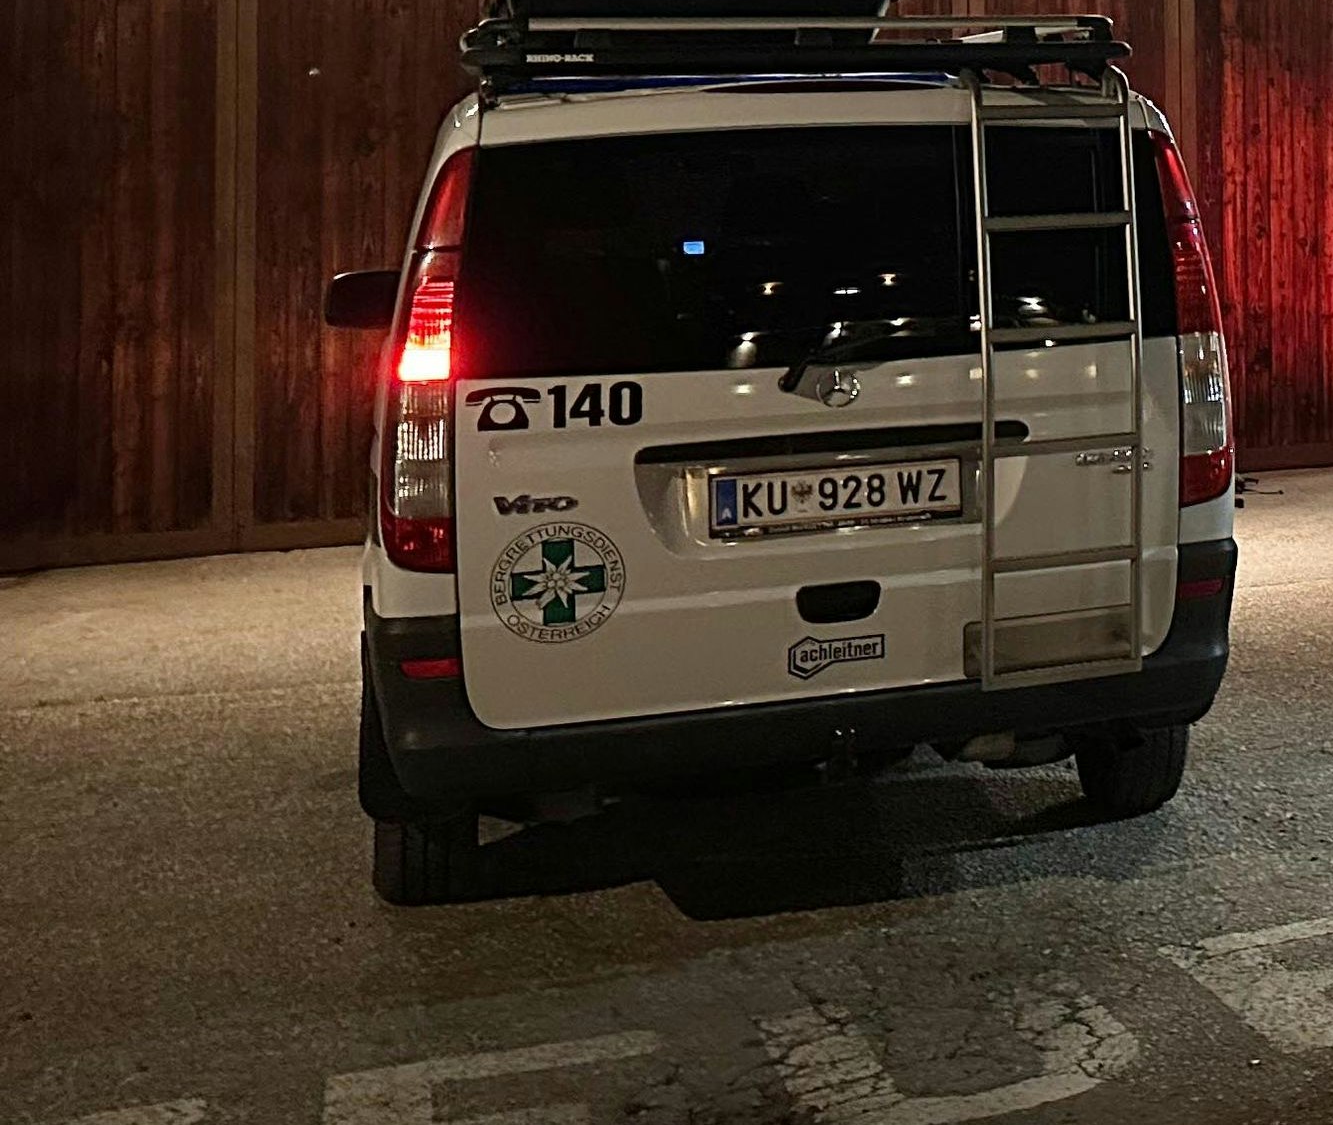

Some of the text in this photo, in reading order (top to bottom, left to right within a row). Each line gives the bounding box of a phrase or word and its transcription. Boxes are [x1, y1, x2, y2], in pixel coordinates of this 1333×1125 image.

[547, 381, 643, 429] 140
[741, 468, 947, 519] KU 928 WZ
[494, 524, 624, 607] BERGRETTUNGSDIENST
[800, 641, 879, 663] achleitner
